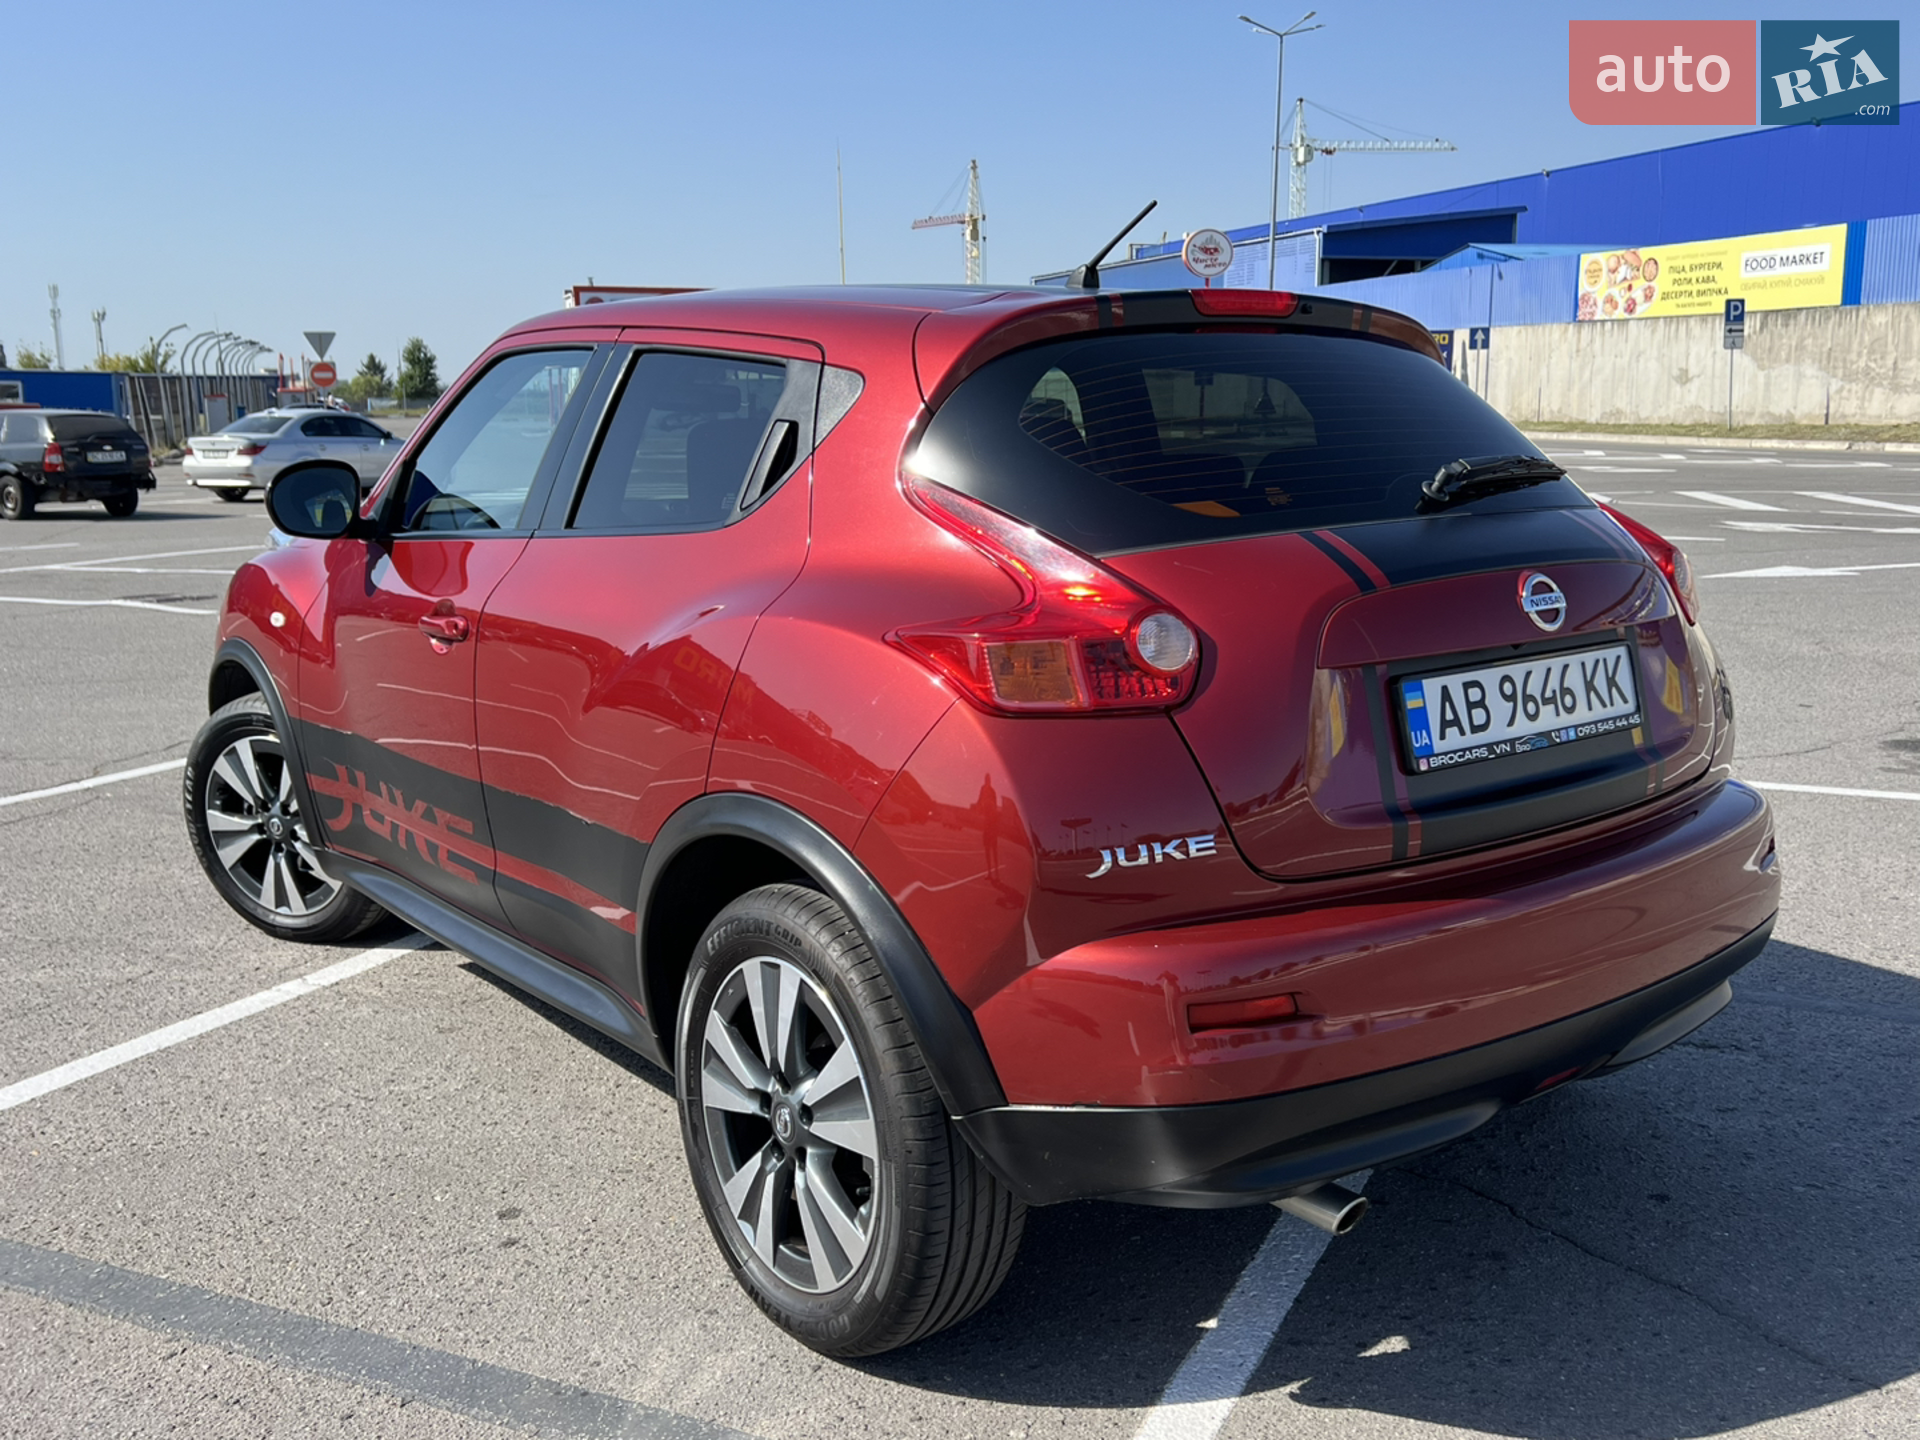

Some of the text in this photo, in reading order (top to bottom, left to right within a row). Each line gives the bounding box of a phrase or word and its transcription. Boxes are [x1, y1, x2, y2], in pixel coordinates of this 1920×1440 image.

[1688, 261, 1724, 273] БУРГЕРИ,
[1744, 255, 1777, 272] FOOD
[1779, 251, 1825, 267] MARKET
[1672, 275, 1718, 287] РОЛИ, КАВА,
[1660, 286, 1729, 302] ДЕСЕРТИ, ВИПІЧКА
[1730, 301, 1742, 321] P
[1439, 655, 1629, 741] AB 9646 KK
[1577, 714, 1641, 737] 093 545 44 45
[1411, 729, 1431, 748] UA
[1428, 742, 1511, 768] BROCARS_VN
[1085, 834, 1217, 879] JUKE
